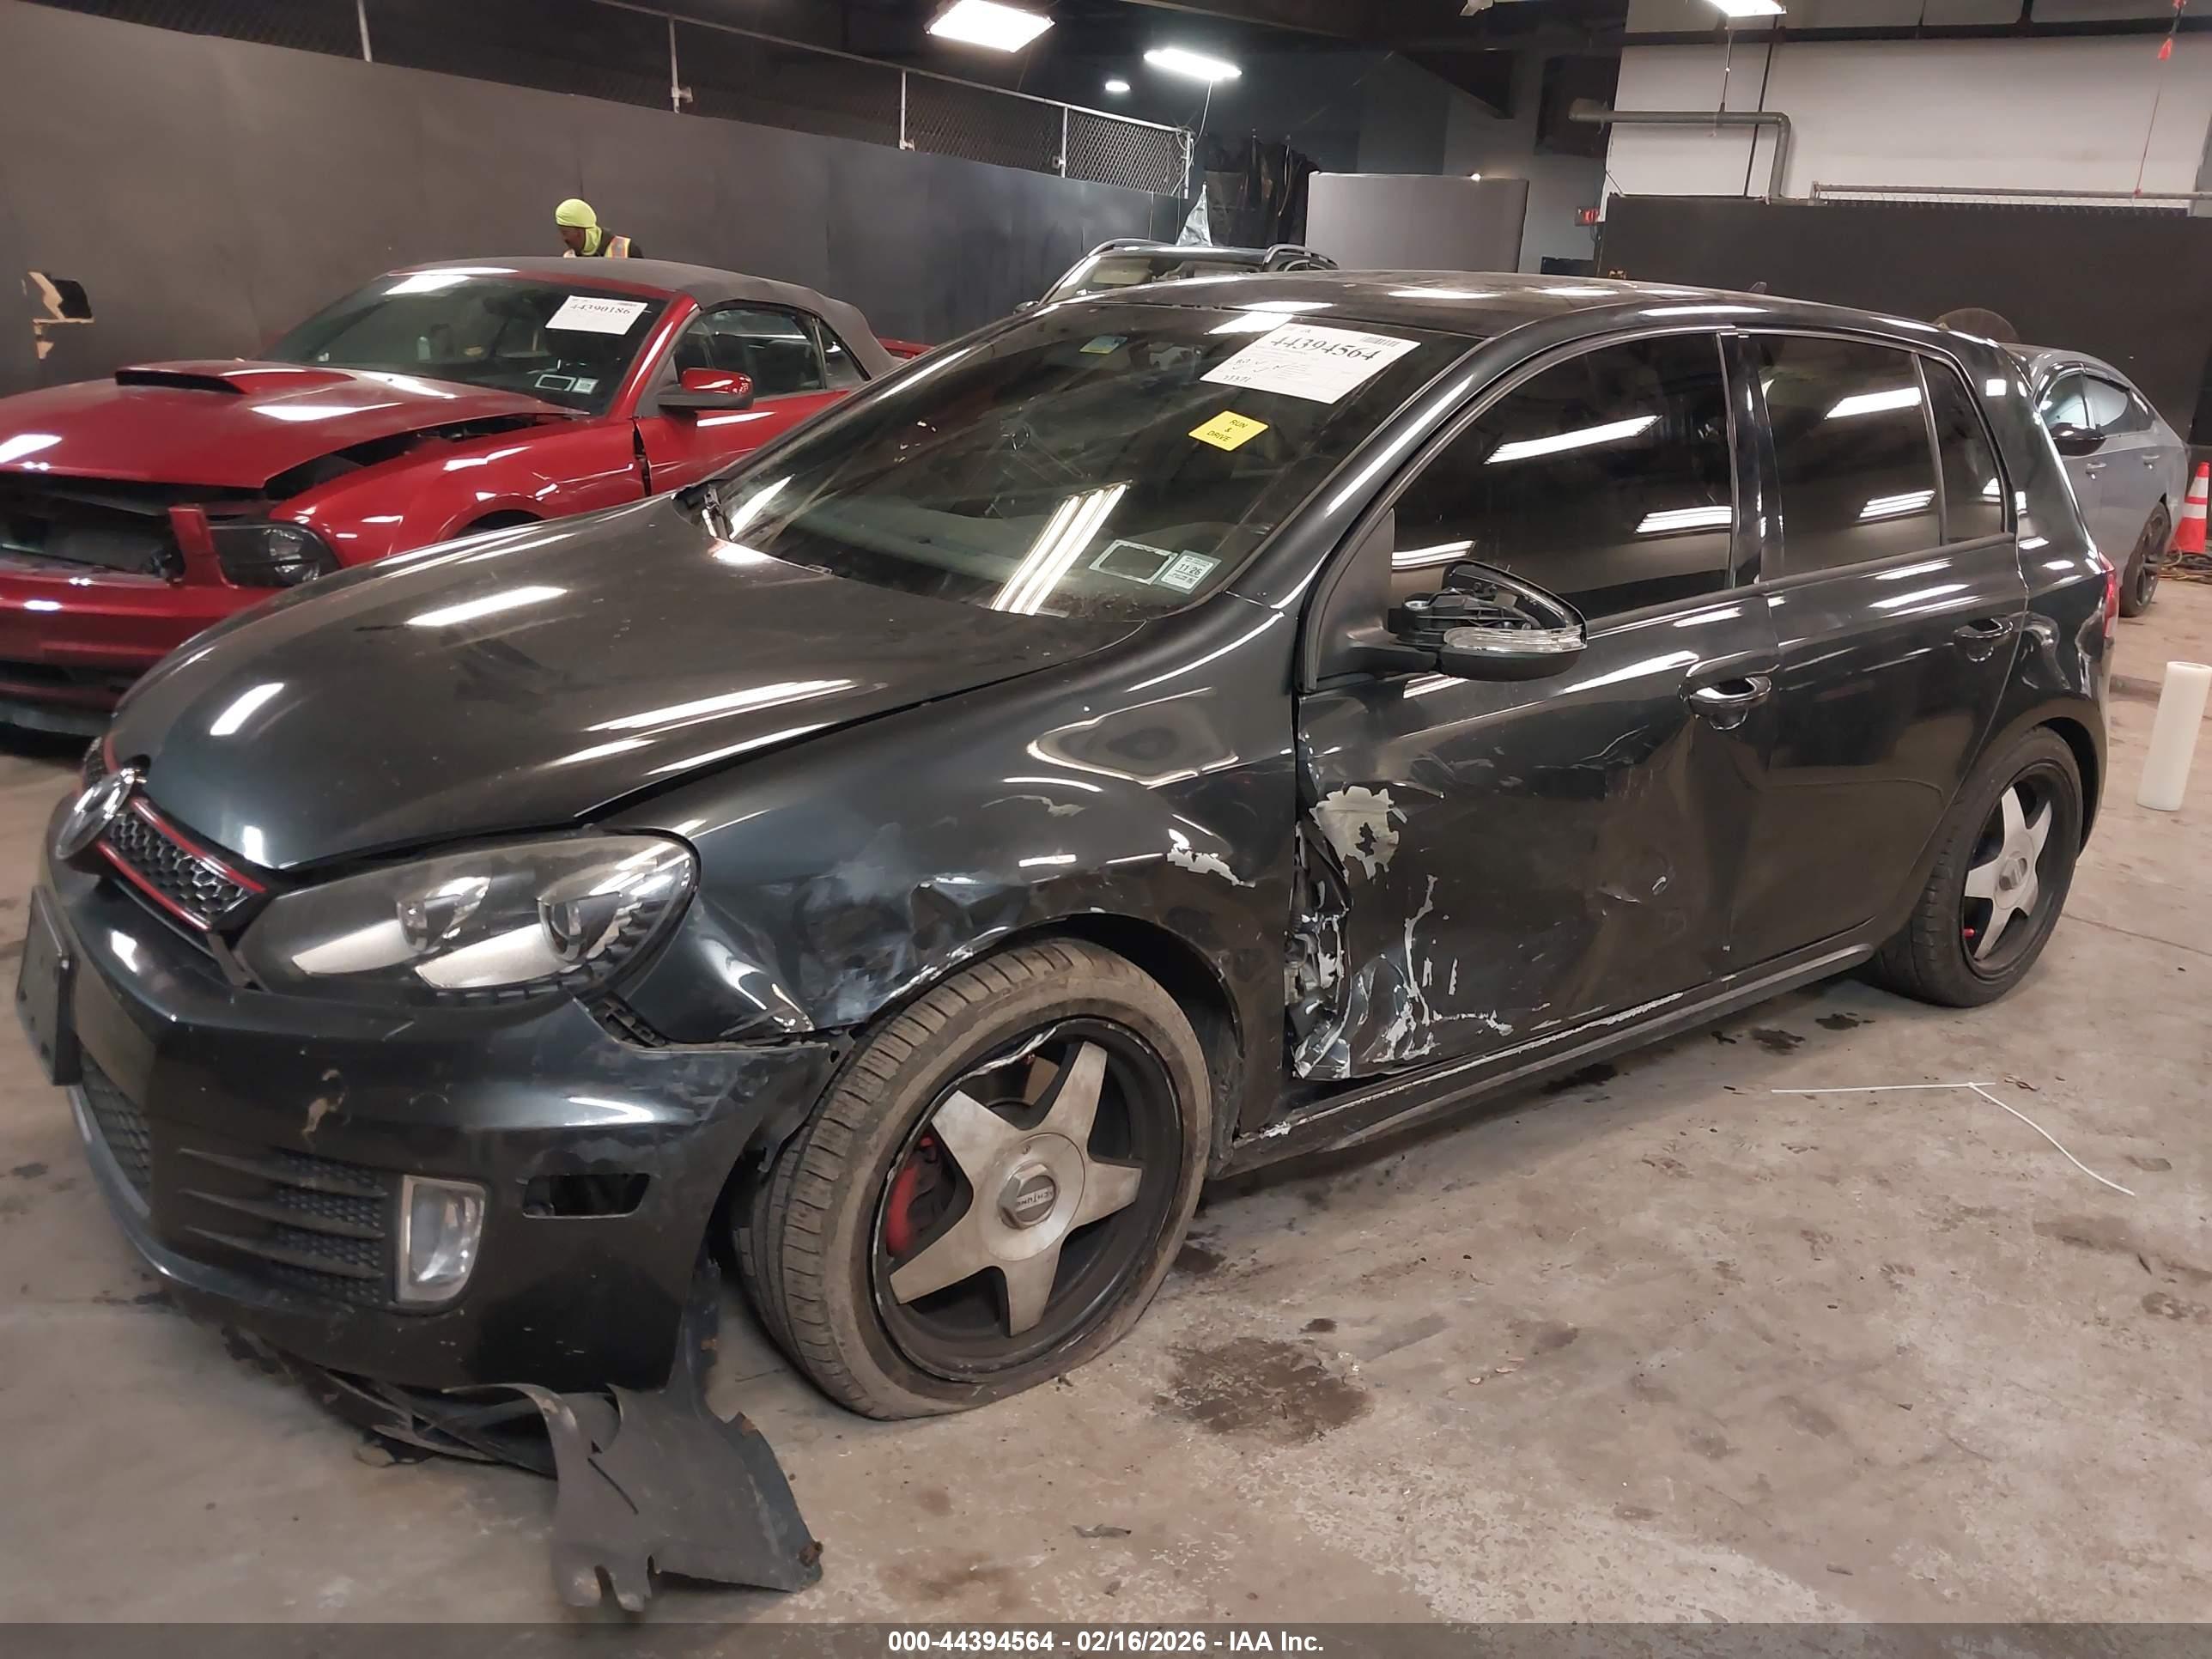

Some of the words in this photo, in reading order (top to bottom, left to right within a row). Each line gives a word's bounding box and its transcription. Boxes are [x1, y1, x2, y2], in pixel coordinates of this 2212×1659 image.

[1271, 336, 1382, 361] 44394564
[1229, 419, 1248, 428] RUN
[1206, 430, 1232, 441] DRIVE
